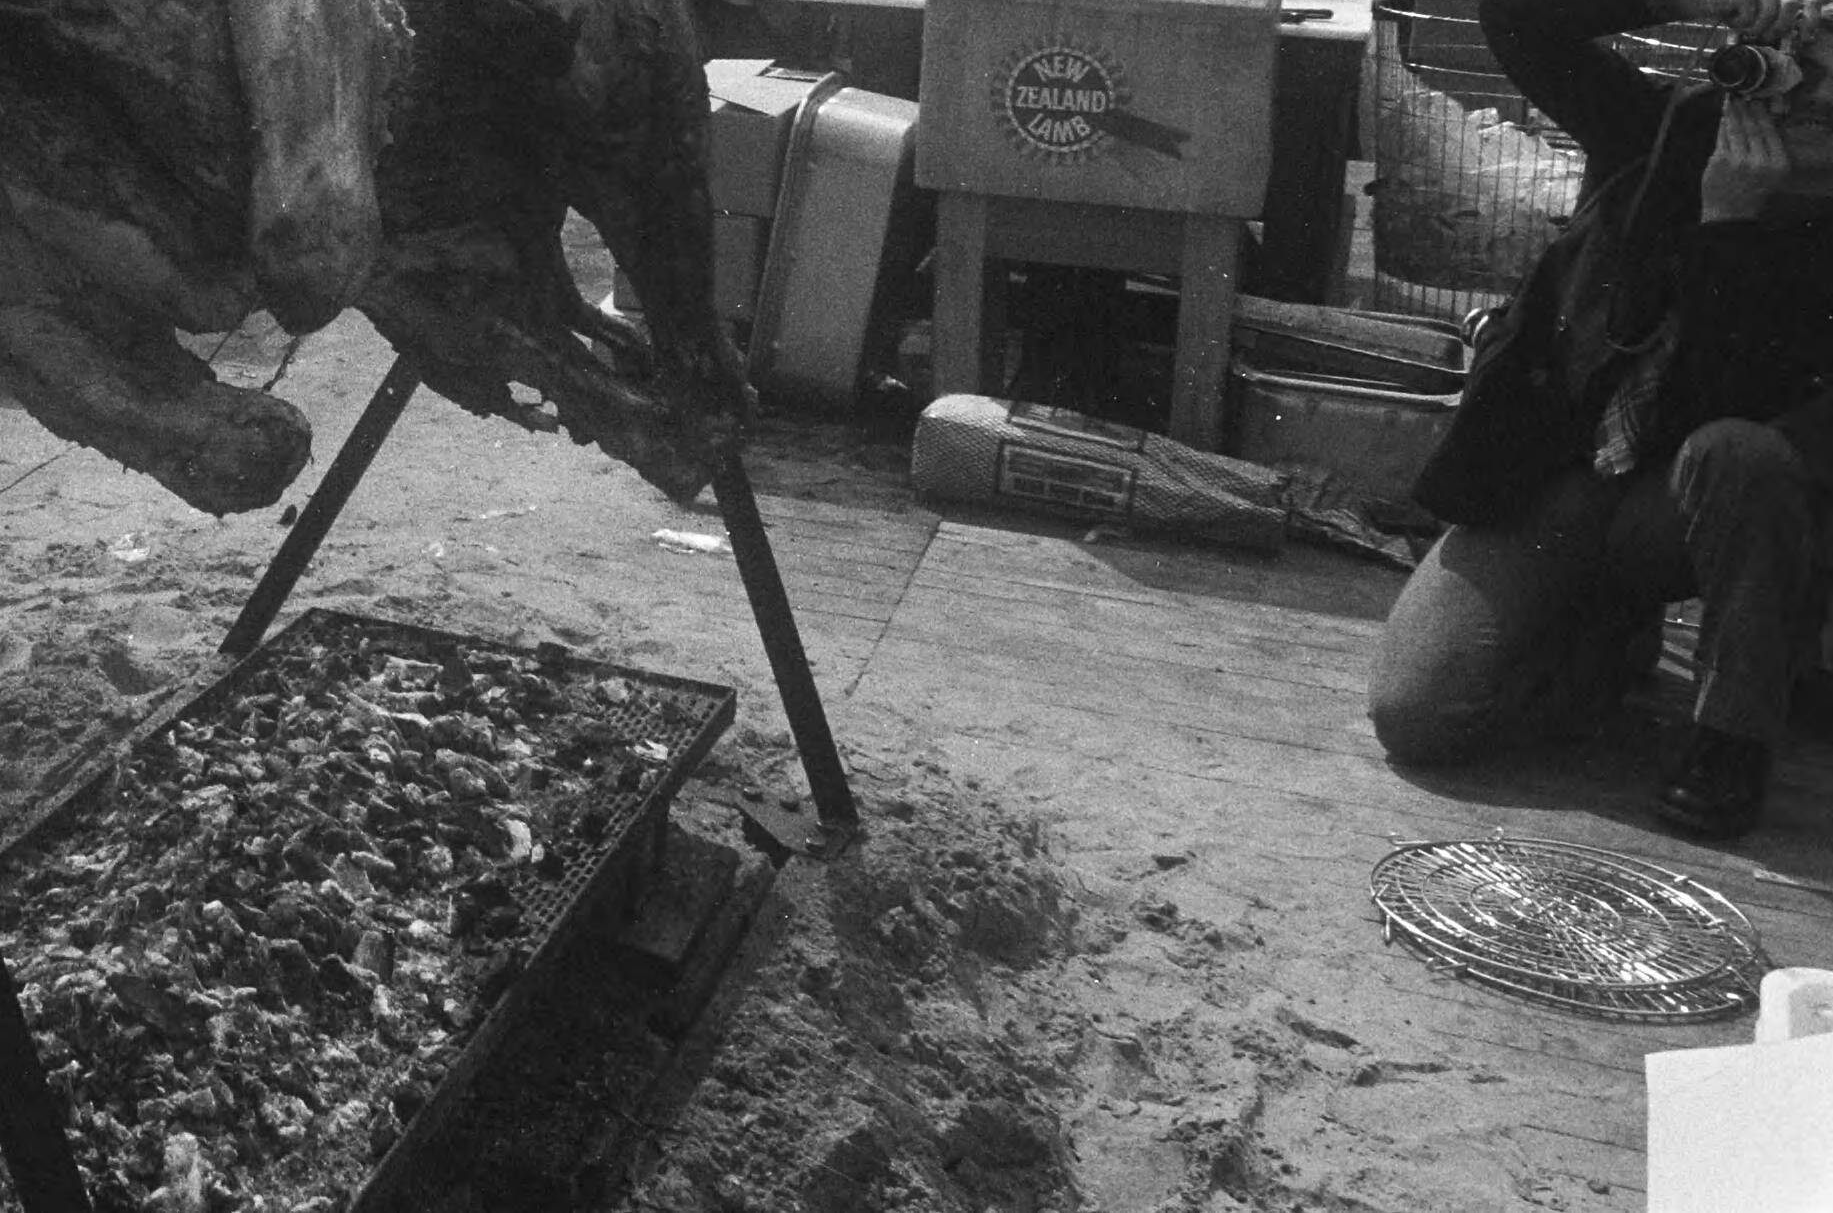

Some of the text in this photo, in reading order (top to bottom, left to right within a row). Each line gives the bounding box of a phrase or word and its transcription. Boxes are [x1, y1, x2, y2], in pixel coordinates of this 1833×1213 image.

[1033, 55, 1091, 84] NEW
[1015, 86, 1107, 113] ZEALAND
[1027, 112, 1092, 143] LAMB
